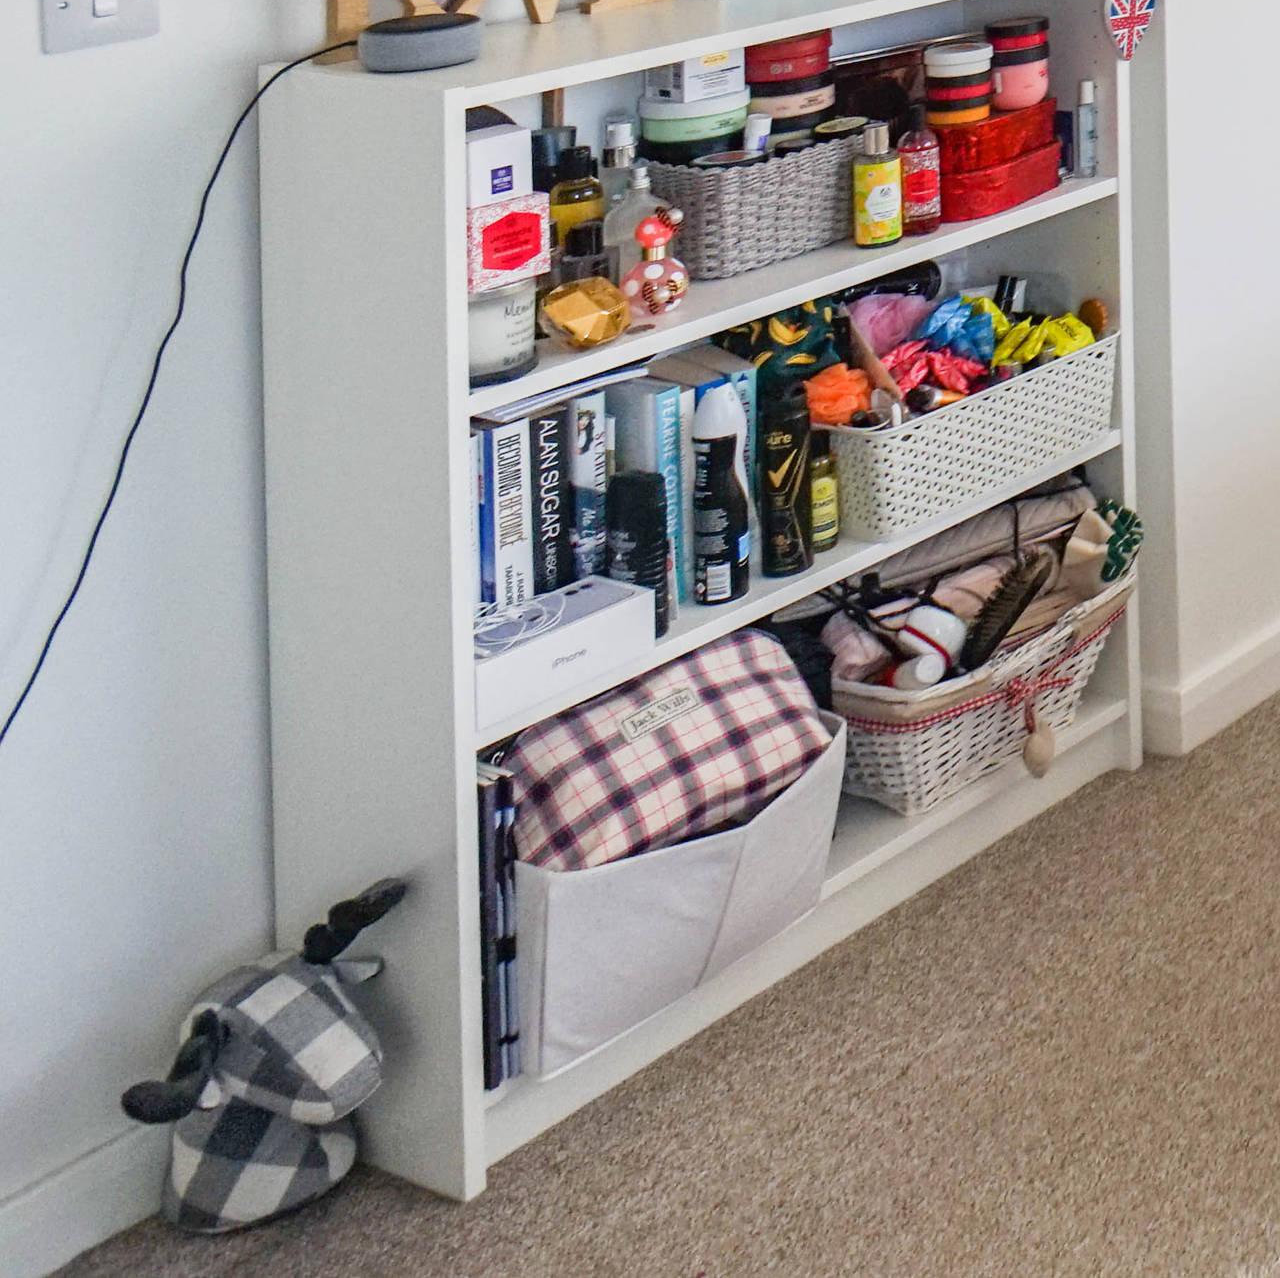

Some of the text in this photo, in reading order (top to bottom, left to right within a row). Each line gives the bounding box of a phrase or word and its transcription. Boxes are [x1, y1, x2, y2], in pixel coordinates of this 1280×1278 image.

[538, 419, 558, 469] ALAN
[661, 396, 678, 459] FEARNE
[497, 433, 528, 551] BECOMING BEYONCÉ
[540, 470, 560, 542] SUGAR
[552, 649, 587, 669] iPhone
[630, 708, 656, 733] Jack
[657, 693, 692, 713] Wills
